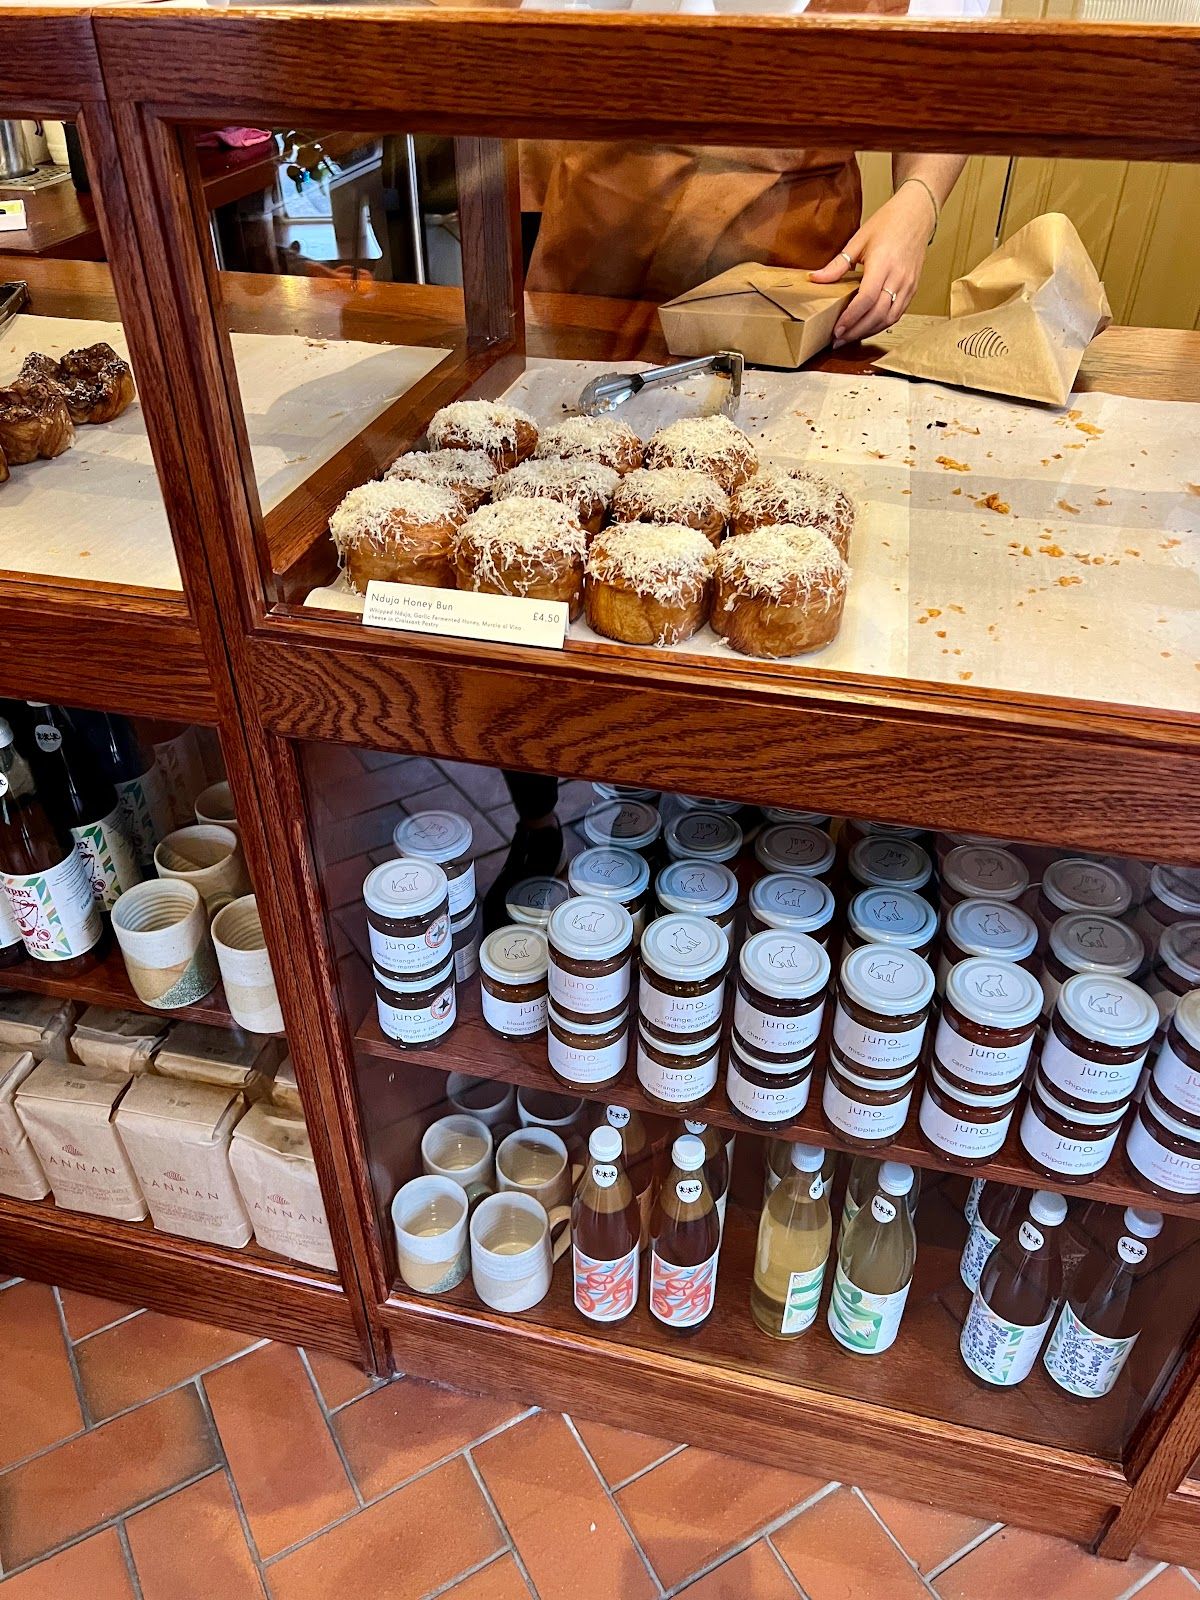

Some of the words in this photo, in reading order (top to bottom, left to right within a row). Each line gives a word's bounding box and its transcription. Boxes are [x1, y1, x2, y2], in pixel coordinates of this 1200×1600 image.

[371, 593, 400, 606] Nduja
[403, 597, 433, 611] Honey
[436, 600, 453, 611] Bun
[369, 607, 394, 615] Whipped
[413, 612, 430, 620] Garlic
[532, 611, 560, 623] £4.50
[394, 617, 421, 625] Croissant
[421, 620, 439, 629] Pastry
[502, 1024, 538, 1032] peppercorn
[654, 1017, 686, 1030] pistachio
[746, 1030, 768, 1045] cherry
[777, 1039, 800, 1047] coffee
[848, 1045, 866, 1058] miso
[951, 1058, 974, 1072] carrot
[1064, 1079, 1098, 1095] chipotle
[738, 1100, 759, 1114] cherry
[936, 1132, 958, 1147] carrot
[959, 1143, 986, 1151] masala
[49, 1155, 116, 1175] ANNAN
[1041, 1151, 1073, 1167] chipotle
[151, 1179, 219, 1200] ANNAN
[254, 1202, 323, 1225] ANNAN
